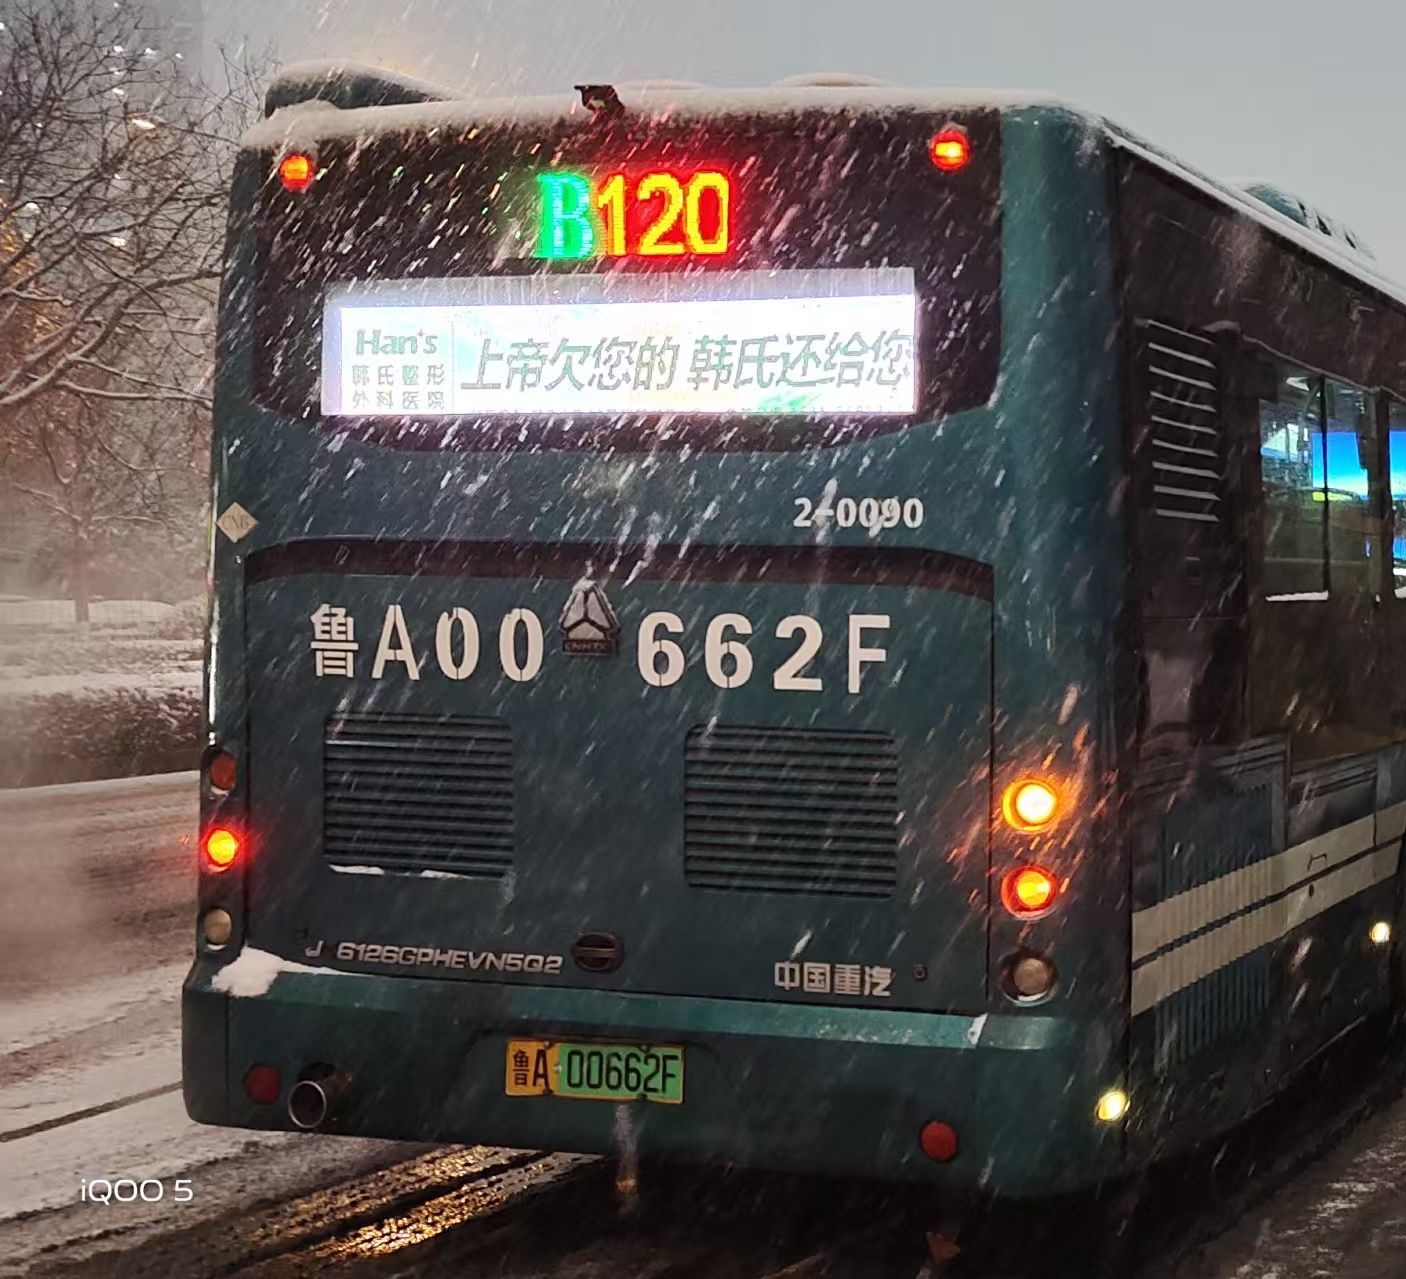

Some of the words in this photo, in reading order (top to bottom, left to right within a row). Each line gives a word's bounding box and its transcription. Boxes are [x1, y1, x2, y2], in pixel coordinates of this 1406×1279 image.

[535, 171, 730, 259] B120
[355, 328, 438, 355] Han's
[459, 335, 680, 391] 上帝欠您的
[687, 328, 912, 390] 韩氏还给您
[793, 497, 924, 528] 2-0090
[774, 960, 894, 997] 中国重汽
